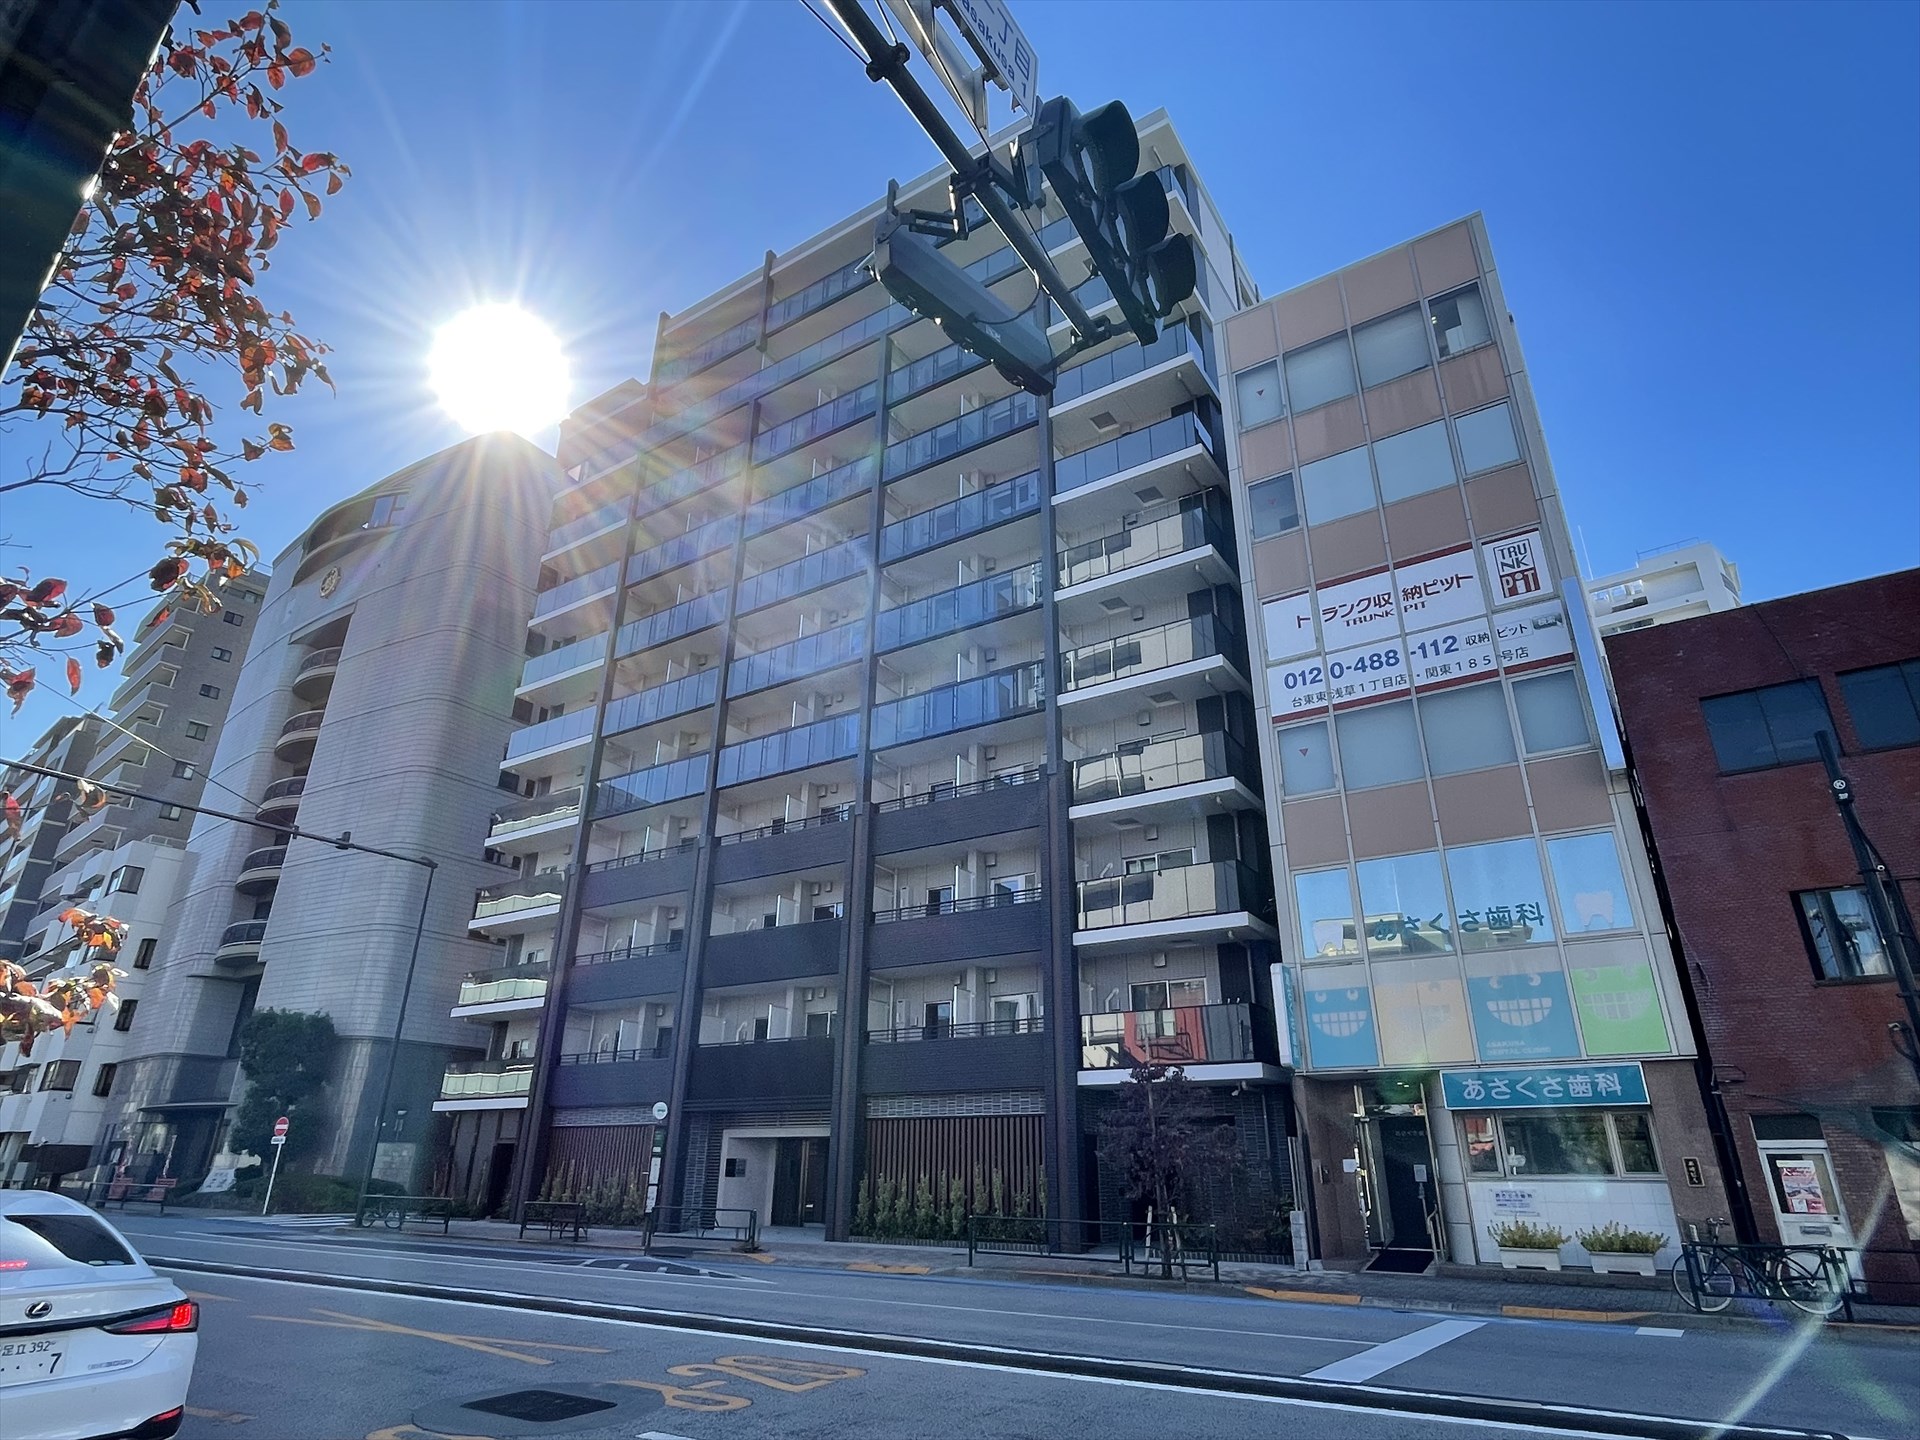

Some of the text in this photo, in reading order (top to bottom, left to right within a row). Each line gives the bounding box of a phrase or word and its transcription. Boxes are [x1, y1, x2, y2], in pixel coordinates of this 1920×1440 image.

[1344, 601, 1428, 627] TRUNK PIT
[1284, 635, 1460, 690] 0120-488-112
[1462, 1072, 1622, 1101] あさくさ歯科
[29, 1341, 51, 1353] 392
